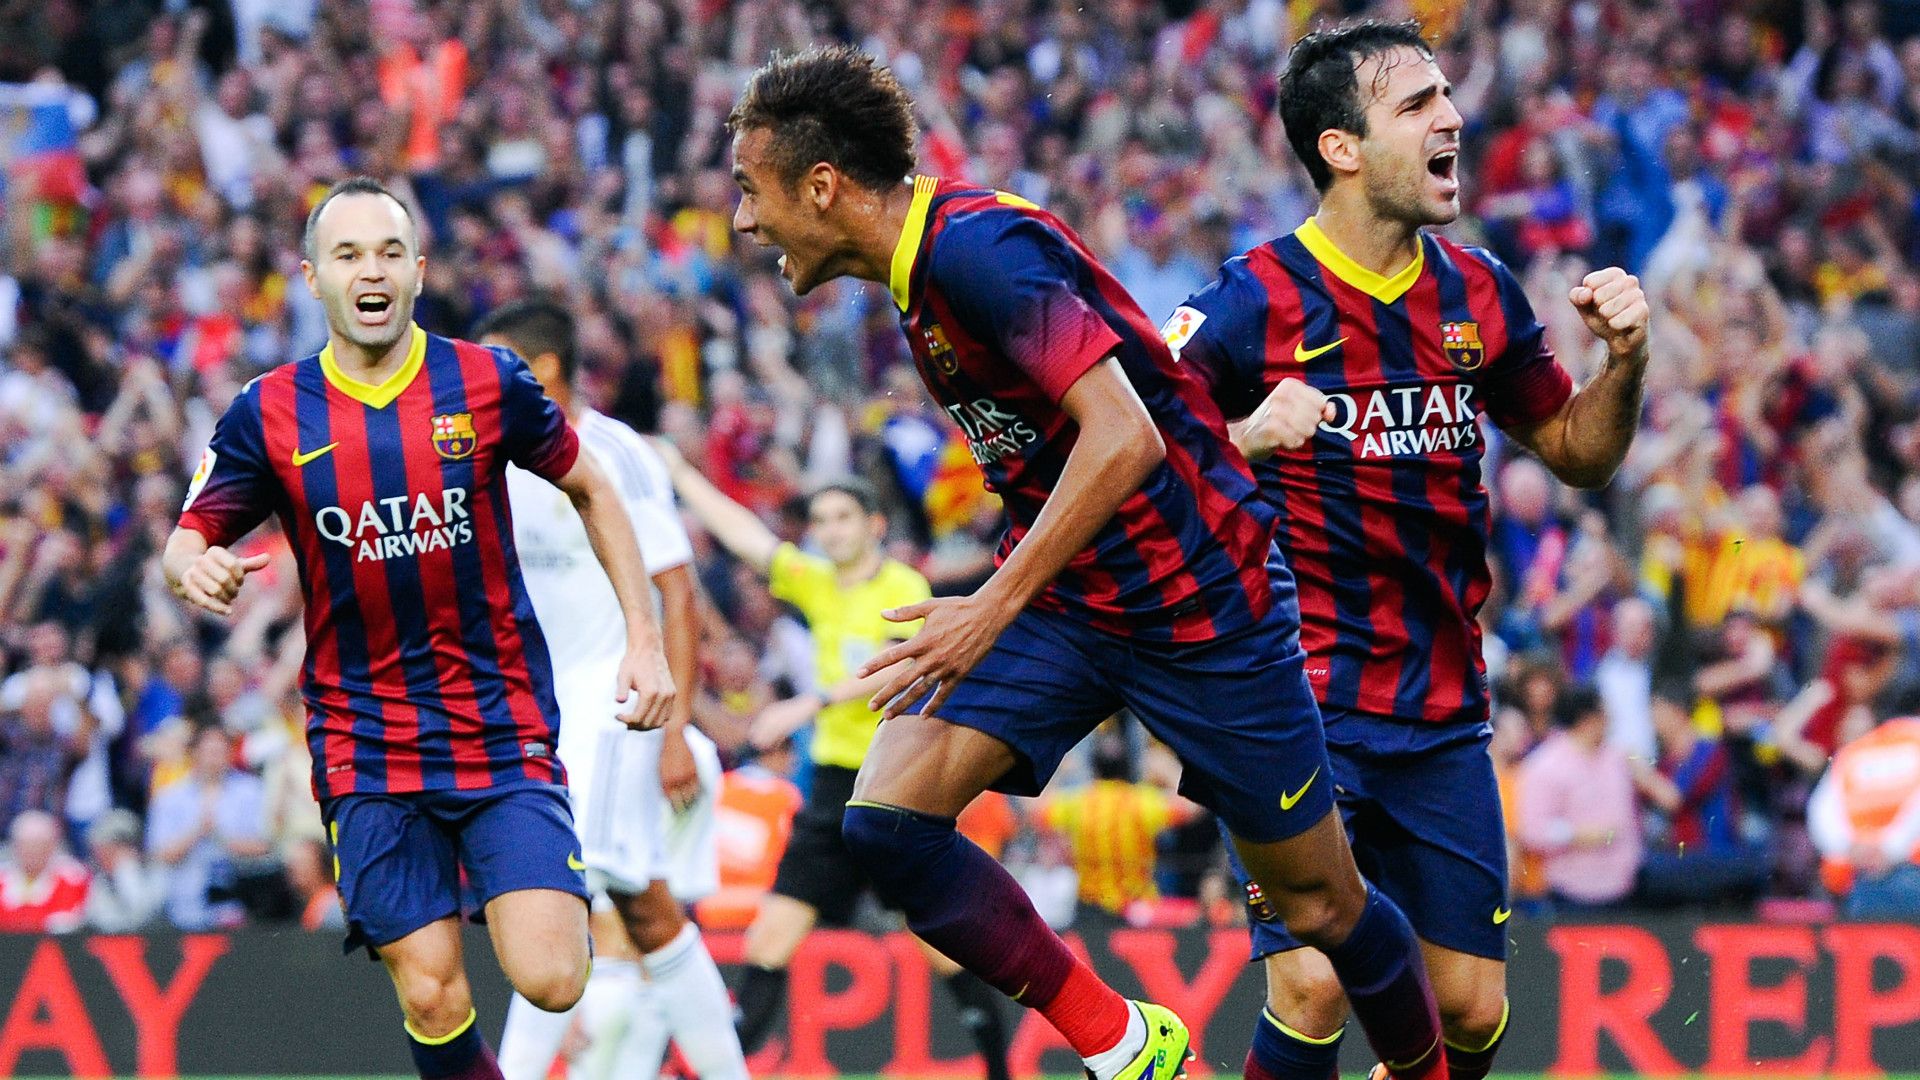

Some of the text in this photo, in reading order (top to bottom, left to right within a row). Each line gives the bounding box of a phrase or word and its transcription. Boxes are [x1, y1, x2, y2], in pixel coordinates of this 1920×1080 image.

[943, 398, 1018, 440] TAR
[1318, 383, 1476, 441] QATAR
[1360, 423, 1476, 459] AIRWAYS
[315, 487, 469, 548] QATAR
[357, 520, 473, 563] AIRWAYS
[0, 933, 232, 1079] AY
[1546, 924, 1920, 1079] REP
